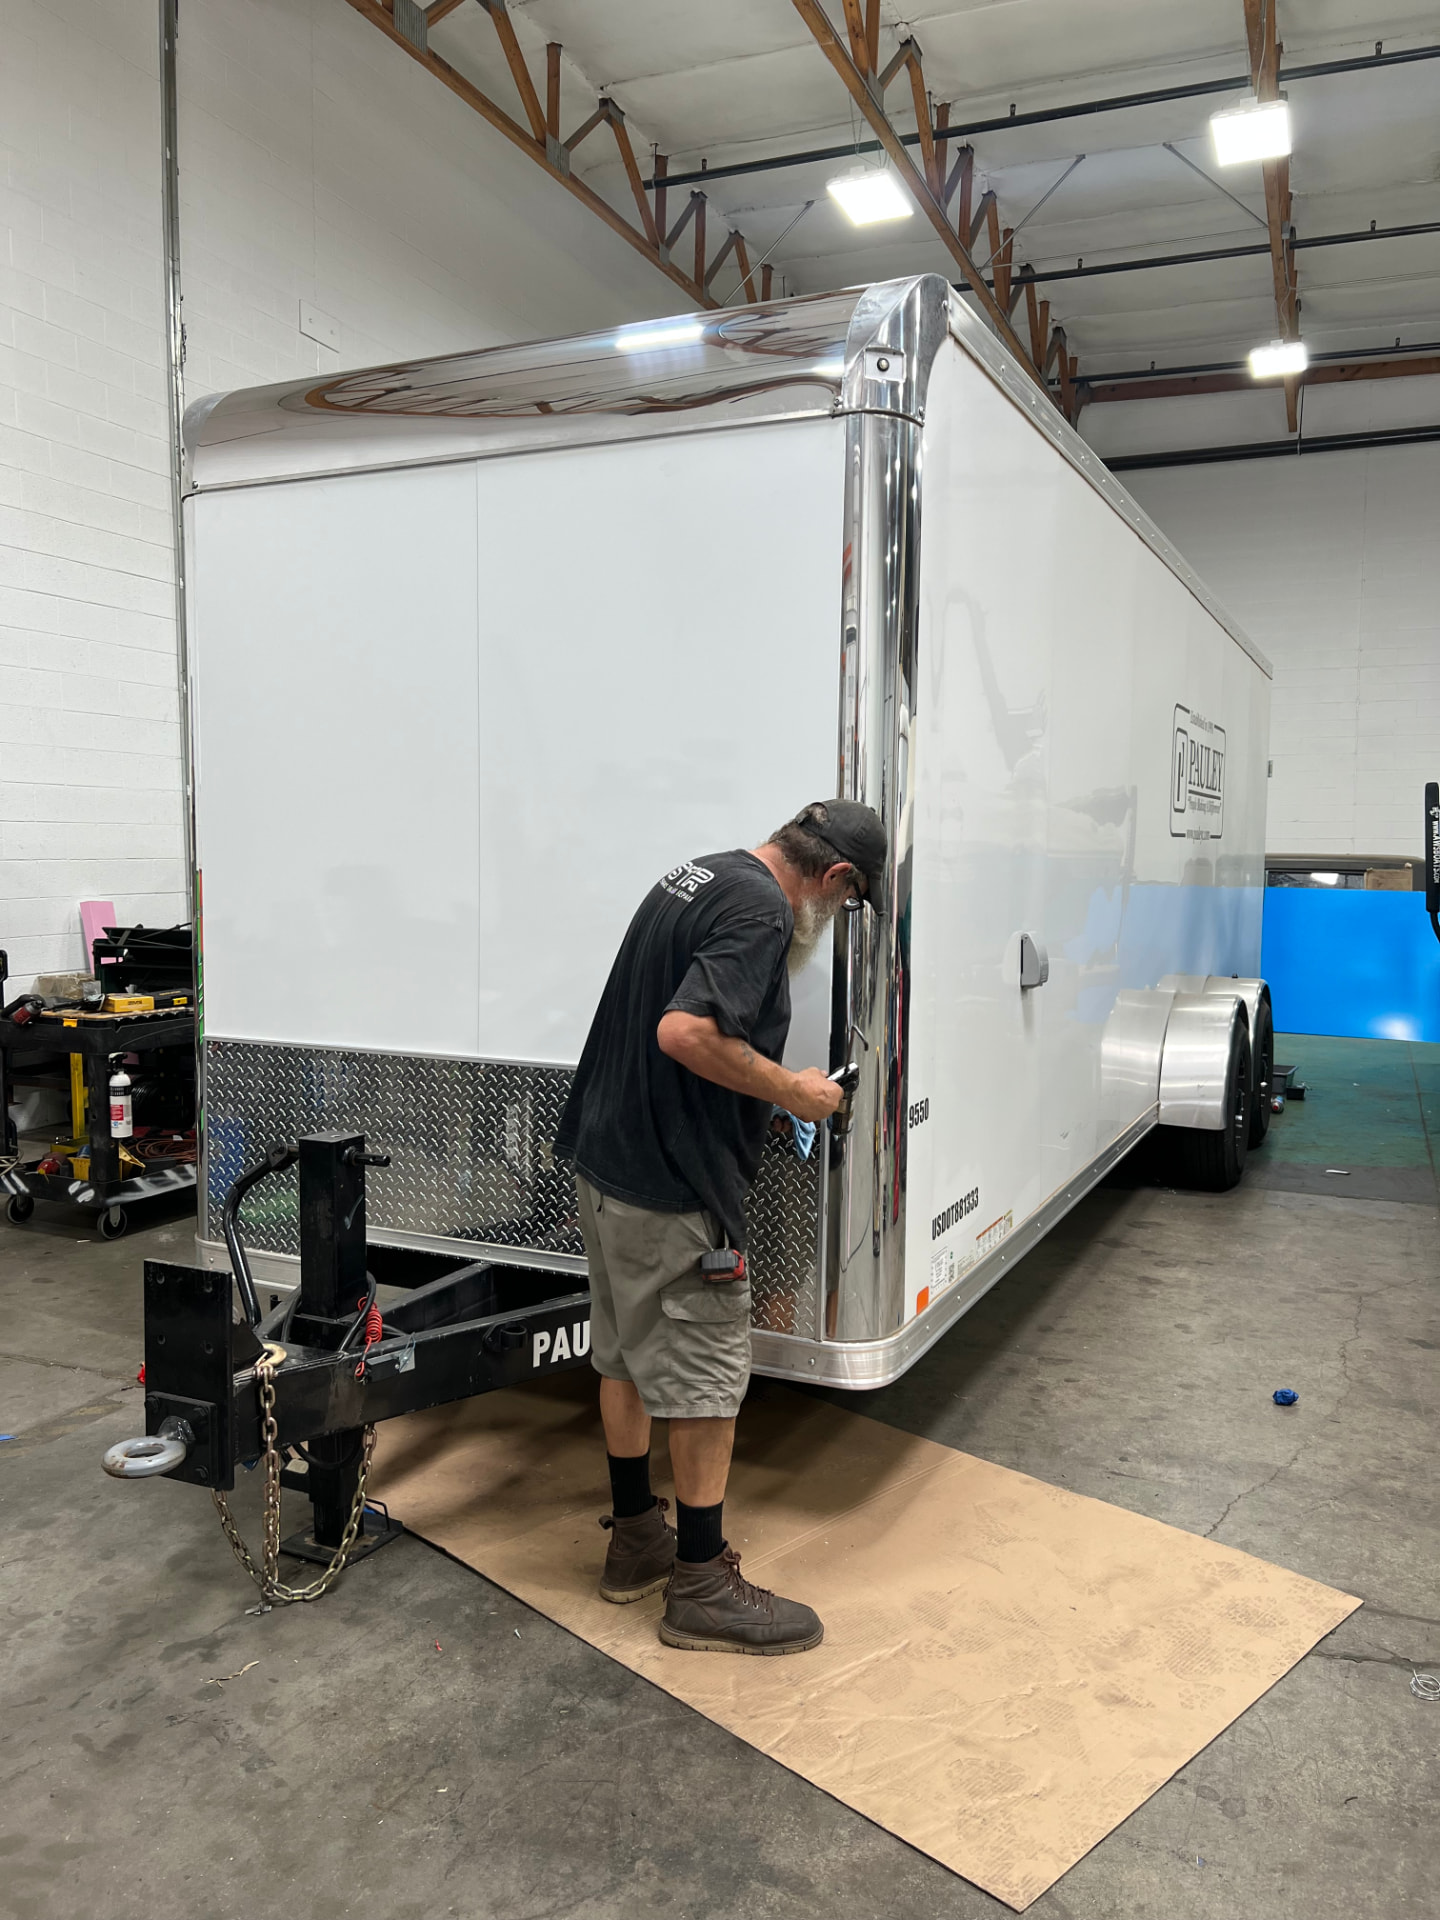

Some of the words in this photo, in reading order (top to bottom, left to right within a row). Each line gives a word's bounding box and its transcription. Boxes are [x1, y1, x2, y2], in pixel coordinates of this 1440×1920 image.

[1188, 739, 1224, 792] PAULEY
[909, 1097, 929, 1129] 9550
[931, 1186, 979, 1241] USDOT881333
